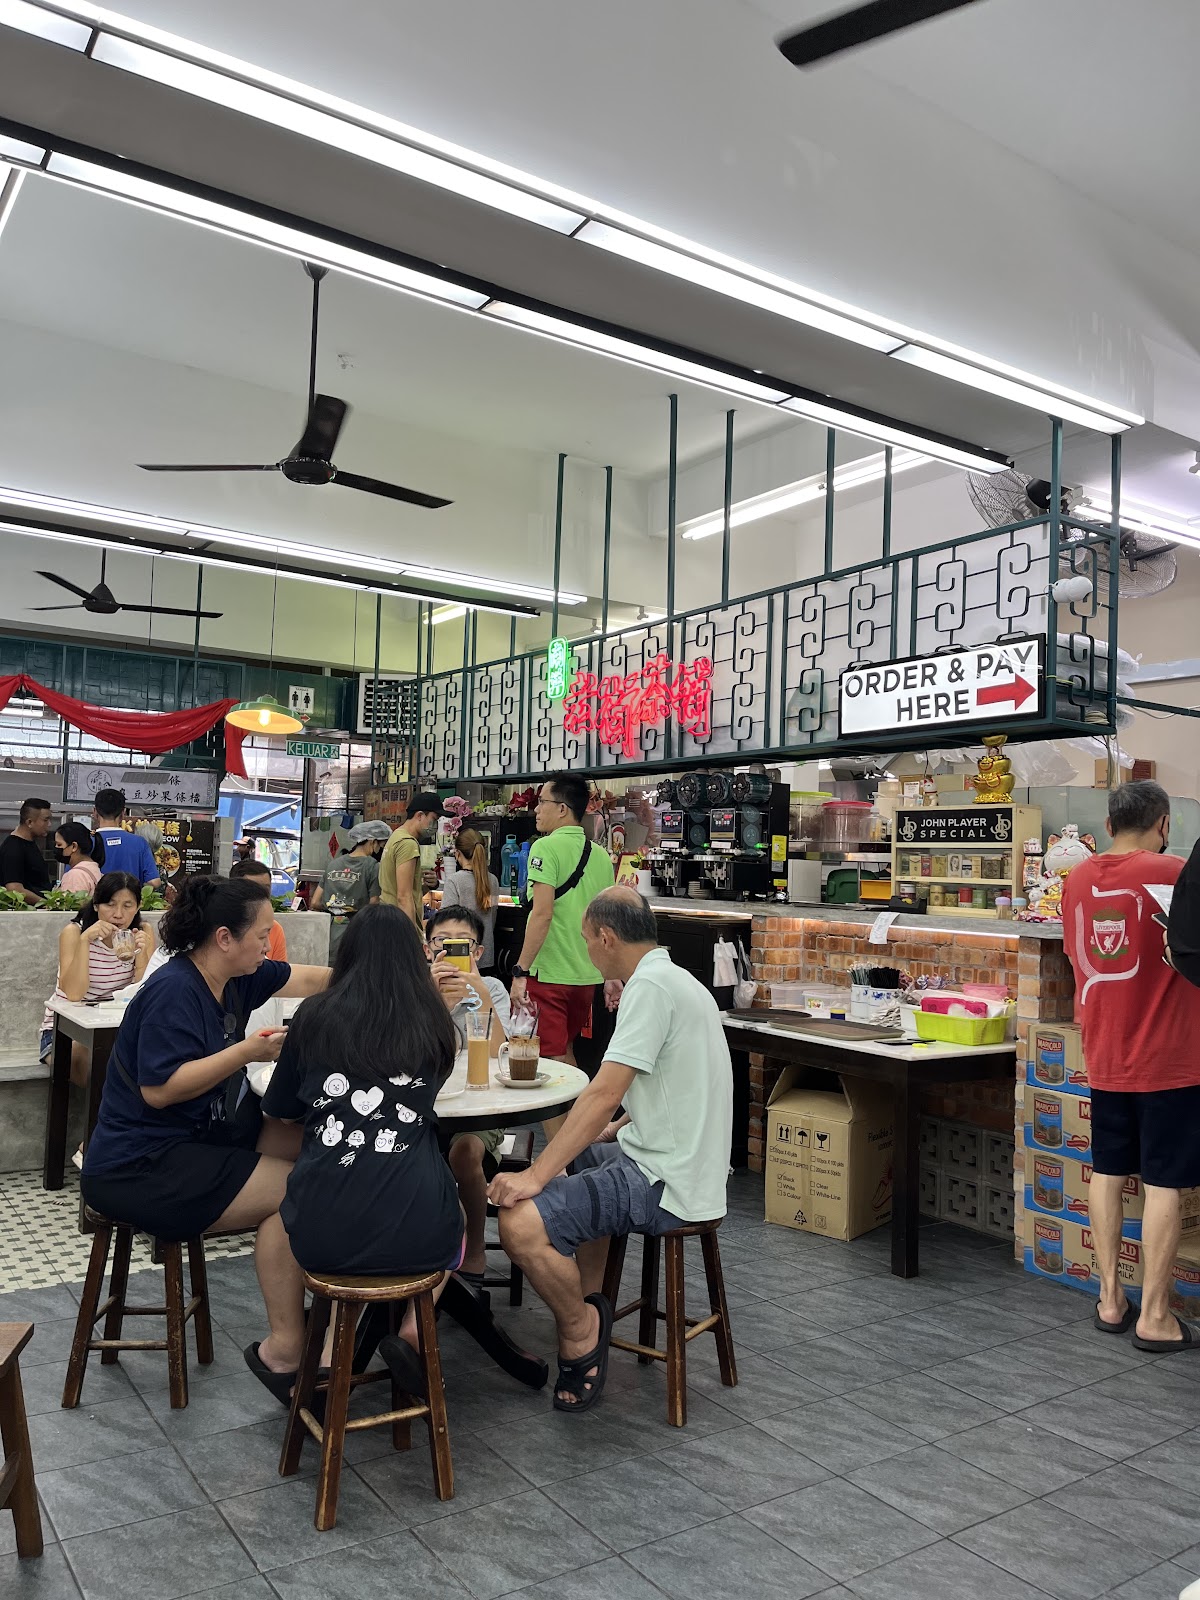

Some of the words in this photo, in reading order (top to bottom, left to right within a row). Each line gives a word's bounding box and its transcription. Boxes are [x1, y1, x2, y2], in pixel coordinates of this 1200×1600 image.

[845, 662, 938, 698] ORDER
[947, 657, 965, 683] &
[976, 644, 1035, 680] PAY
[896, 688, 970, 723] HERE
[288, 742, 329, 758] KELUAR
[920, 818, 946, 828] JOHN
[947, 817, 987, 827] PLAYER
[920, 829, 987, 839] SPECIAL
[1037, 1038, 1062, 1051] MARIGOLD
[1035, 1100, 1059, 1114] MARIGOLD
[1035, 1162, 1061, 1176] MARIGOLD
[1035, 1224, 1061, 1240] MARIGOLD
